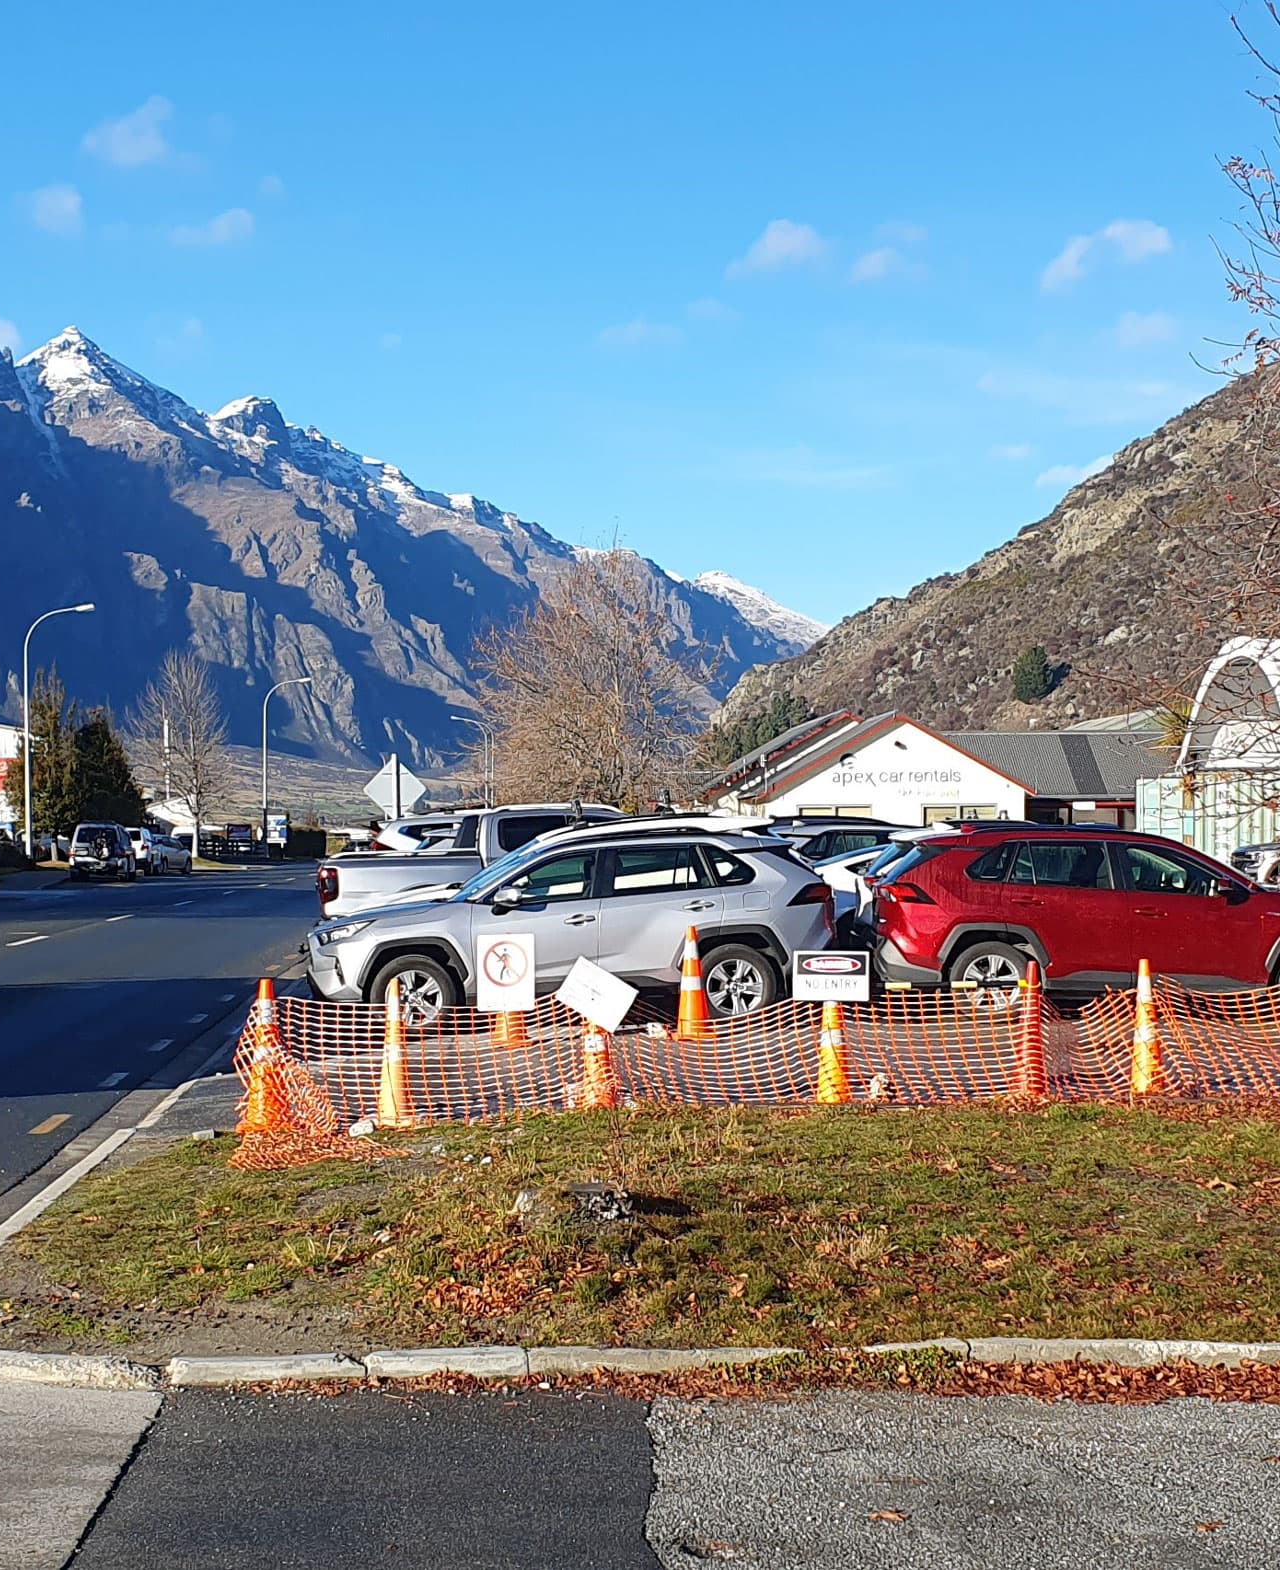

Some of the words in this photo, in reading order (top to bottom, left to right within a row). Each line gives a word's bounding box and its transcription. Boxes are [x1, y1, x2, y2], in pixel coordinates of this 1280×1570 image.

[832, 770, 876, 787] apex
[878, 771, 903, 783] car
[908, 768, 962, 783] rentals
[805, 978, 820, 990] NO
[824, 978, 858, 990] ENTRY
